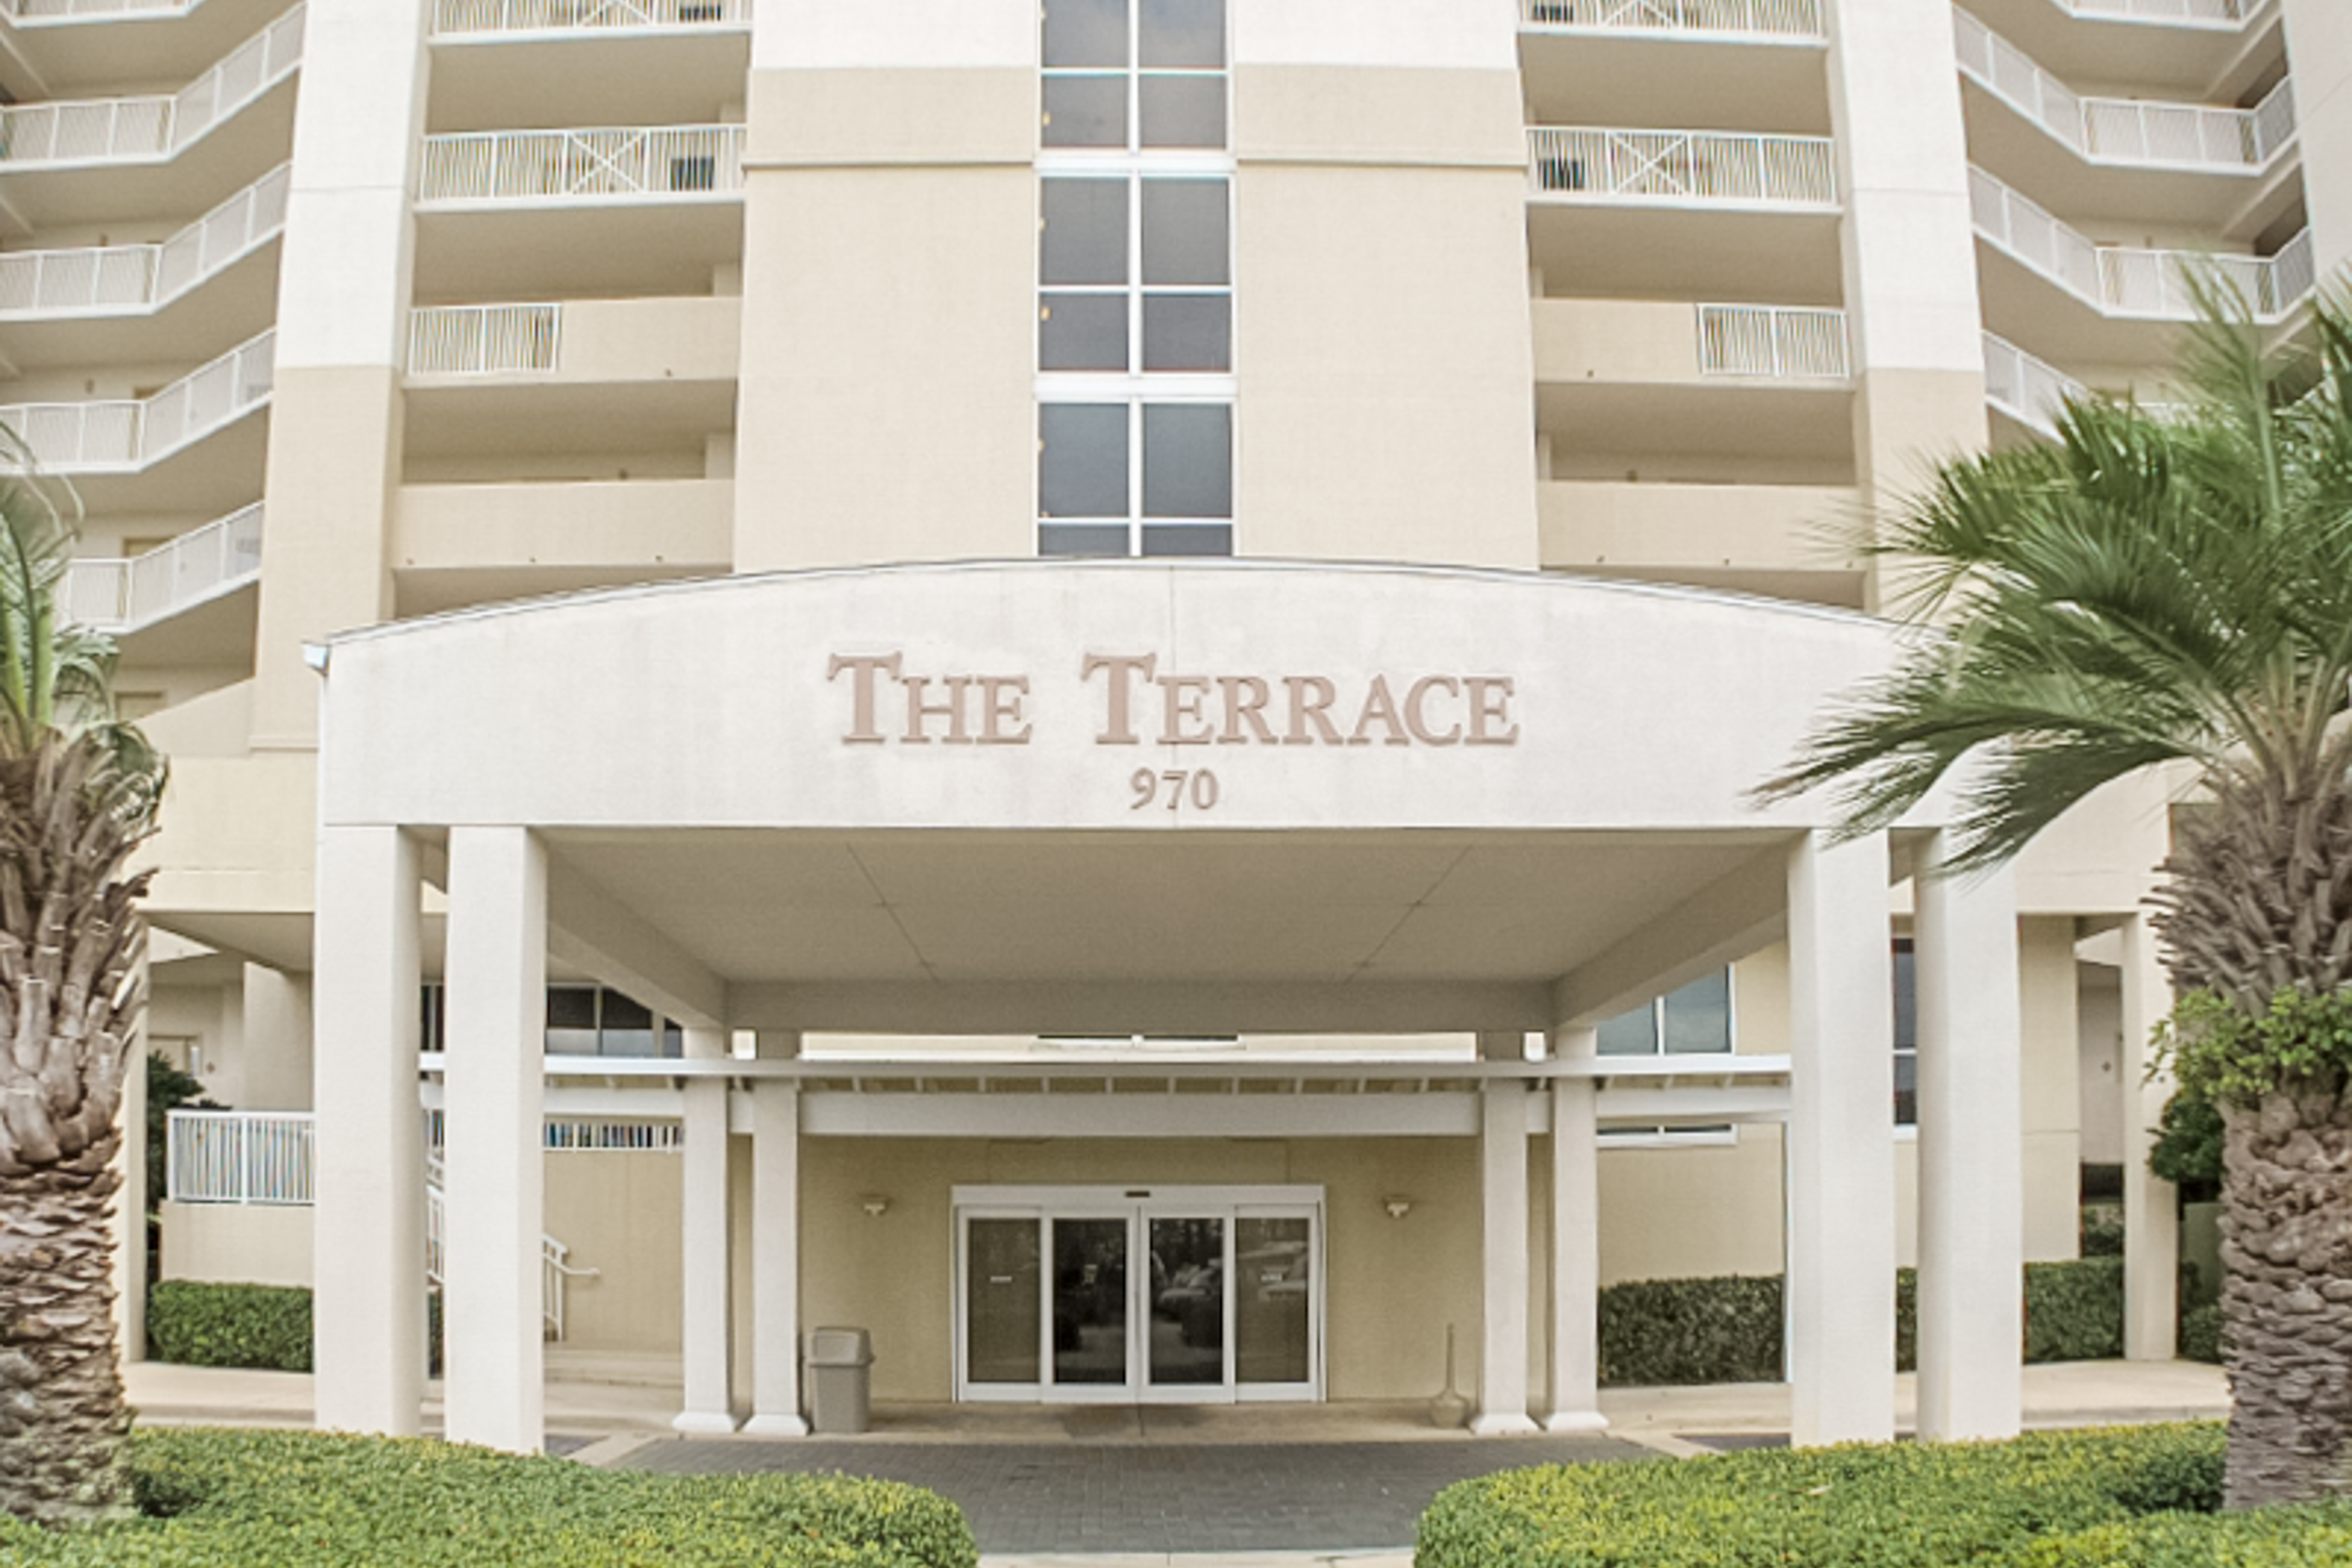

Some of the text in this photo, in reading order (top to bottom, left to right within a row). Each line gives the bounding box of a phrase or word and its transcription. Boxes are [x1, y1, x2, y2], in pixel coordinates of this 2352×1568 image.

[827, 651, 1520, 748] THE TERRACE
[1129, 767, 1219, 811] 970
